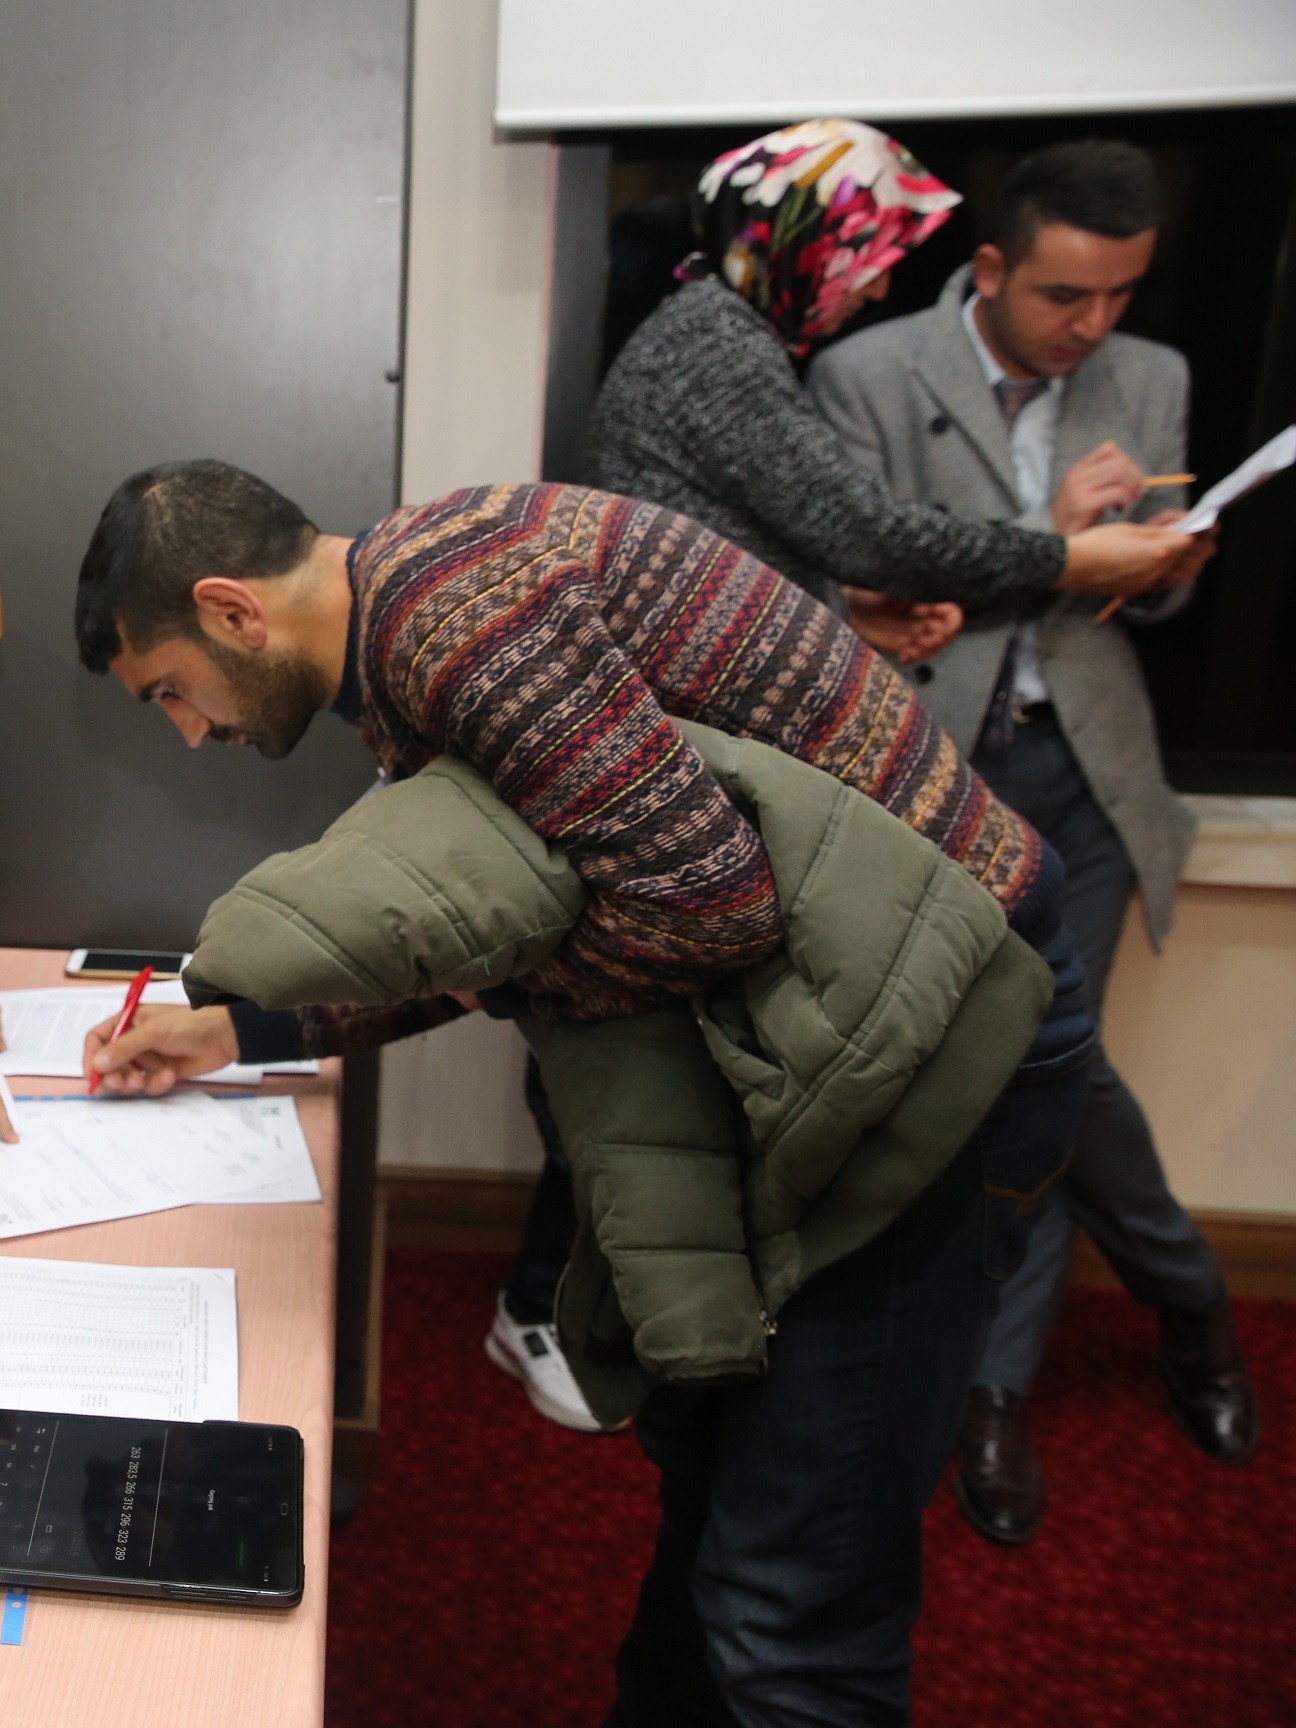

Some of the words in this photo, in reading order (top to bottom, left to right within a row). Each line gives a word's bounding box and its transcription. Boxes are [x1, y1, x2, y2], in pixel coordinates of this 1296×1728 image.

[130, 1446, 142, 1459] 263
[125, 1481, 136, 1494] 266
[122, 1497, 134, 1511] 315
[120, 1513, 132, 1527] 296
[117, 1529, 129, 1544] 323
[114, 1546, 126, 1561] 289
